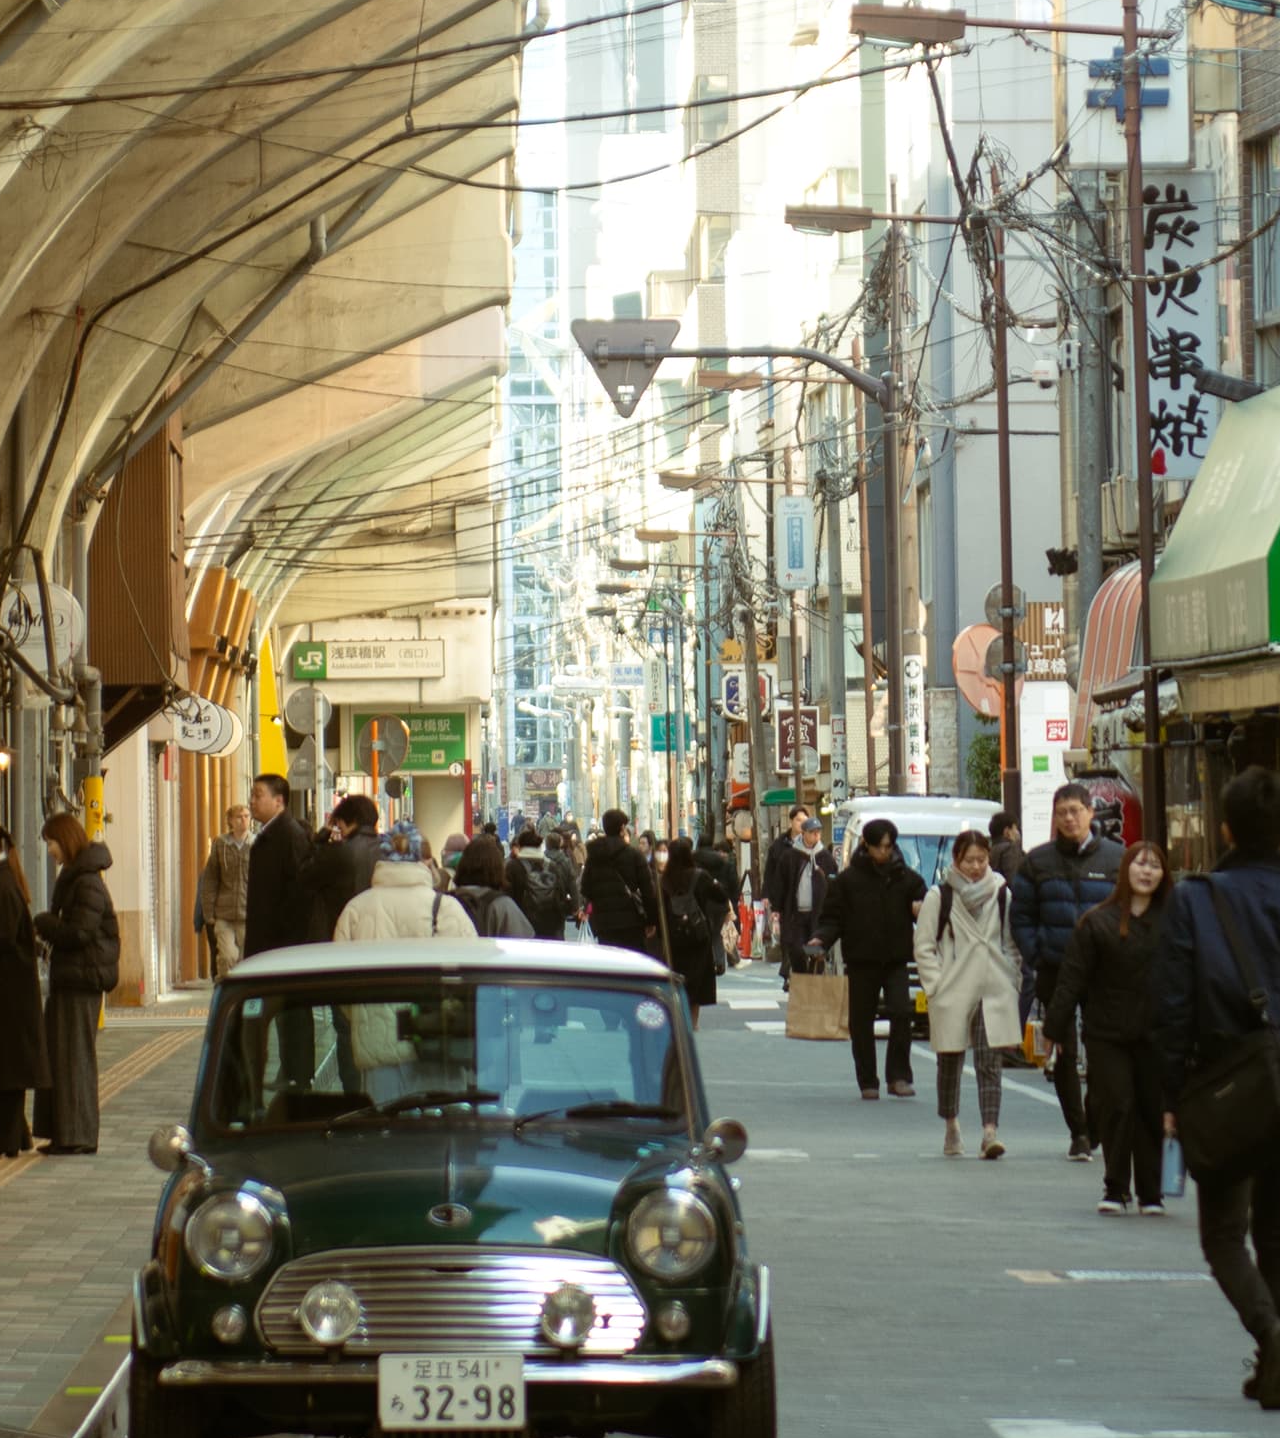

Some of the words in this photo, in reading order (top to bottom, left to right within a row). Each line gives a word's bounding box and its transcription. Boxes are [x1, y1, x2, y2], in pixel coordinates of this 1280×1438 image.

[1140, 182, 1210, 460] 炭火串焼
[298, 650, 323, 666] JR
[331, 645, 386, 660] 浅草橋駅
[414, 1359, 453, 1379] 足立
[457, 1359, 489, 1379] 541
[412, 1384, 516, 1421] 32-98
